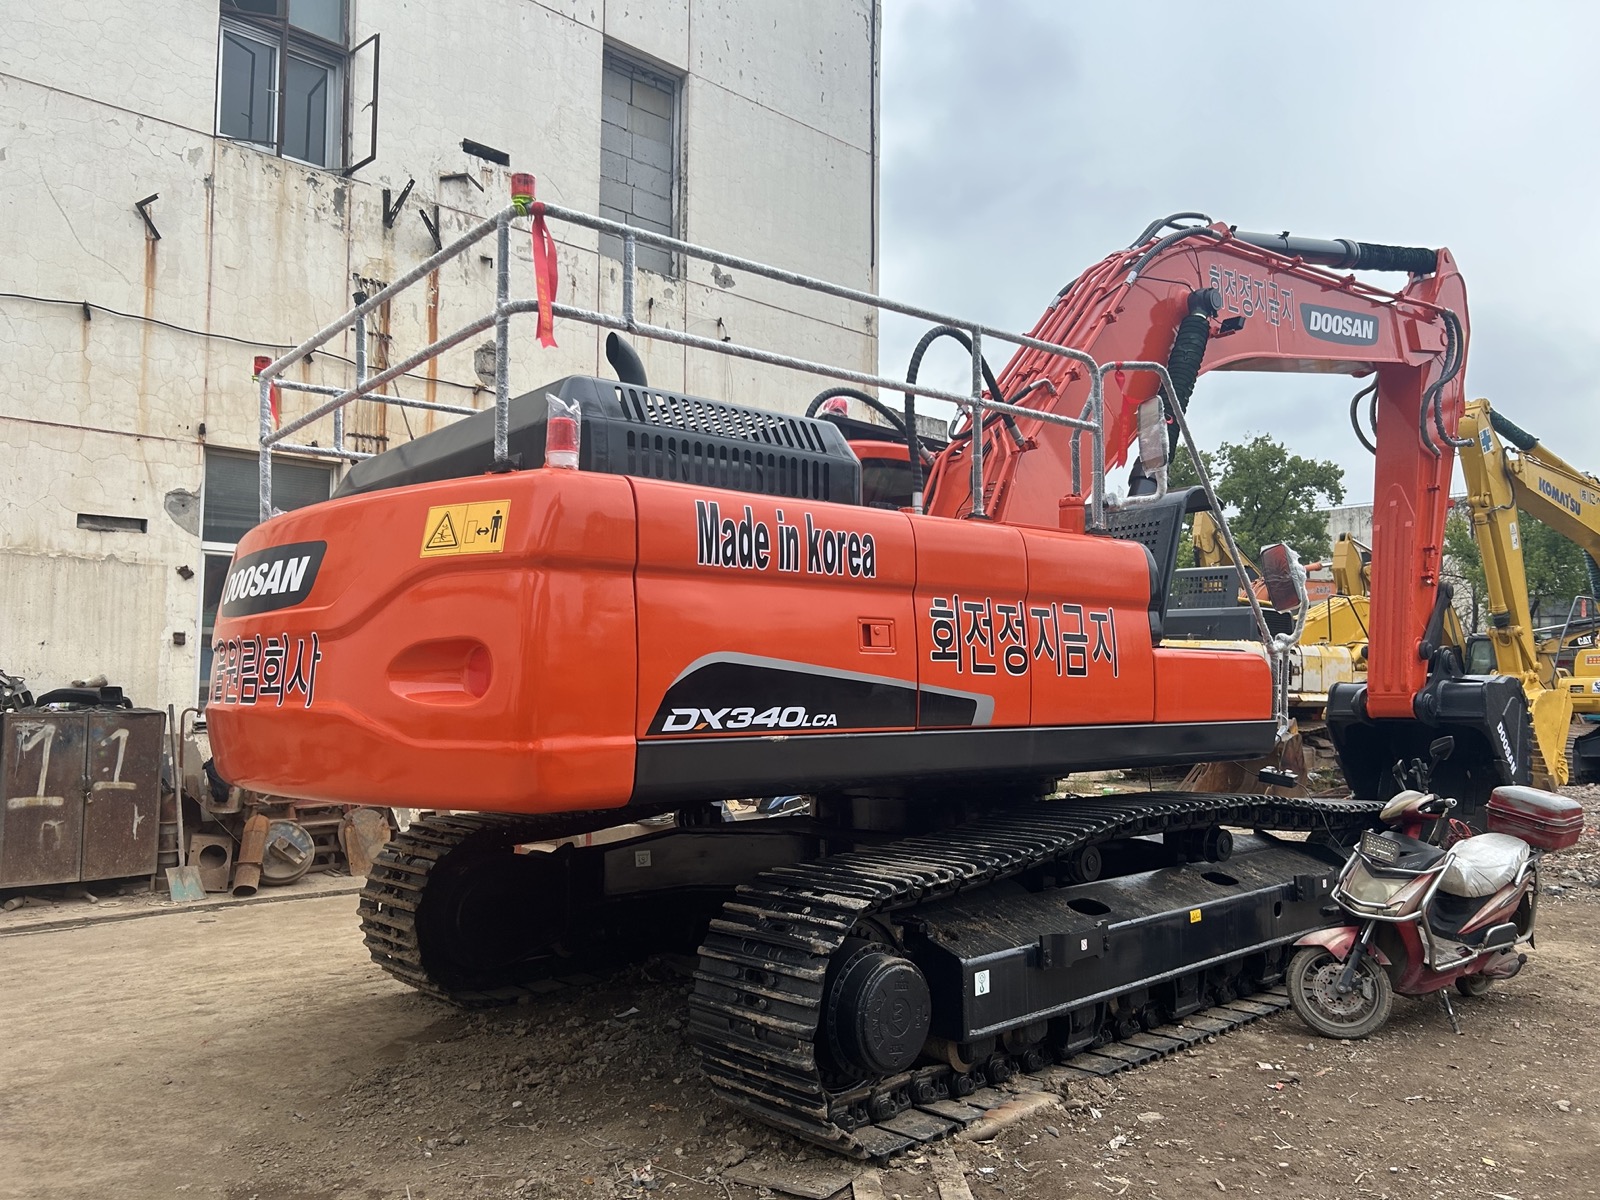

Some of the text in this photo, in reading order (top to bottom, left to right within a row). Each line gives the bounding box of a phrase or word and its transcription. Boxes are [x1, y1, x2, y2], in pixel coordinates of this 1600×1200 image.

[1309, 311, 1374, 340] DOOSAN
[1538, 476, 1581, 516] KOMATSU
[695, 499, 876, 578] Made in korea
[223, 555, 311, 606] DOOSAN
[929, 593, 1119, 679] 회전정지금지
[1577, 635, 1592, 646] CAT
[1496, 721, 1517, 776] DOOSAN
